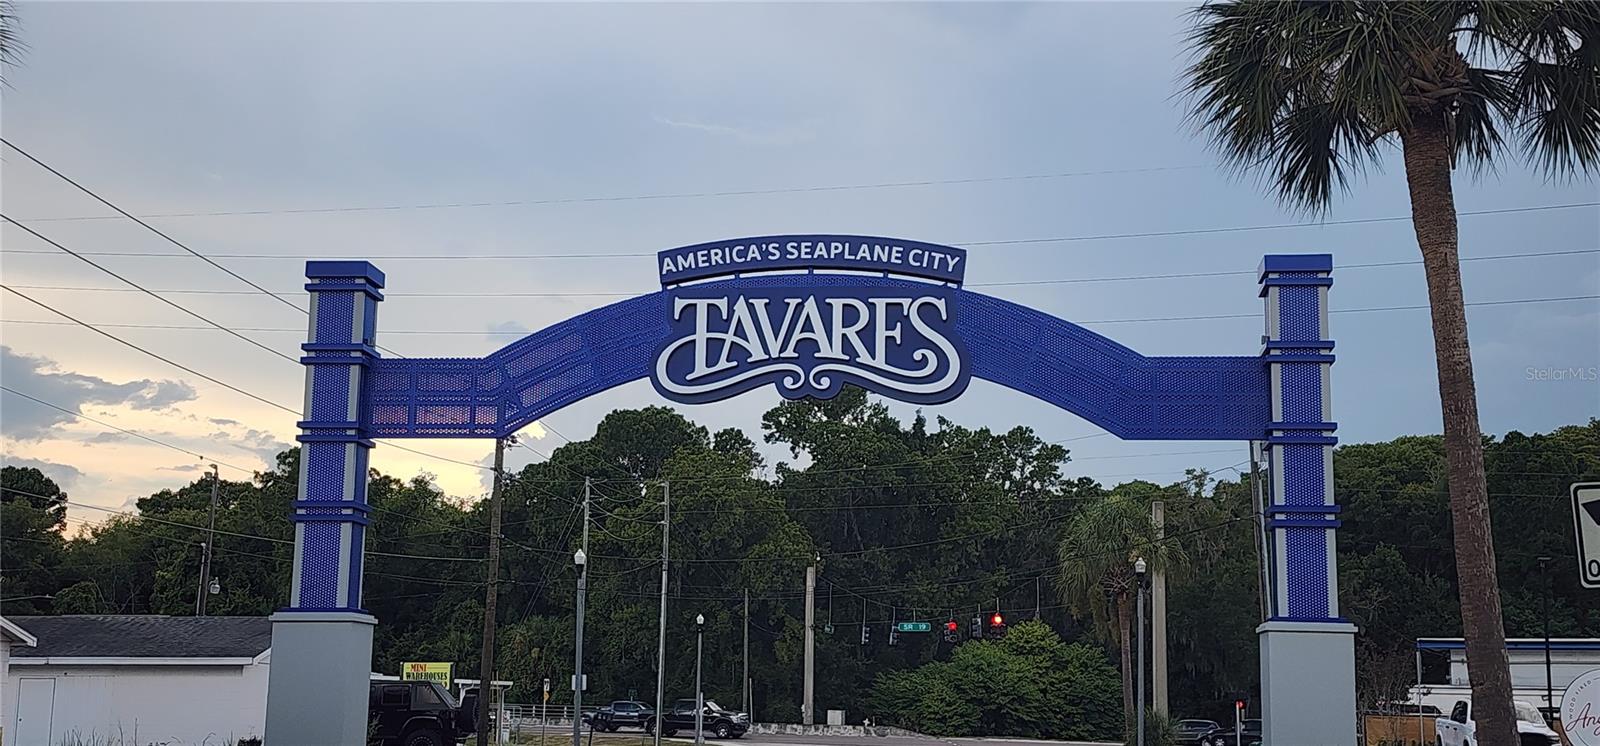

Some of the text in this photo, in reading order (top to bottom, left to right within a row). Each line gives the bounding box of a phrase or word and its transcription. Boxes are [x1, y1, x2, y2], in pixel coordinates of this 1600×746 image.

[661, 242, 960, 275] AMERICA’S SEAPLANE CITY
[656, 294, 961, 394] TAVARES
[1588, 559, 1600, 578] O
[405, 672, 448, 680] WAREHOUSES
[410, 664, 427, 672] MINI
[1569, 680, 1592, 720] WOOD FIRED
